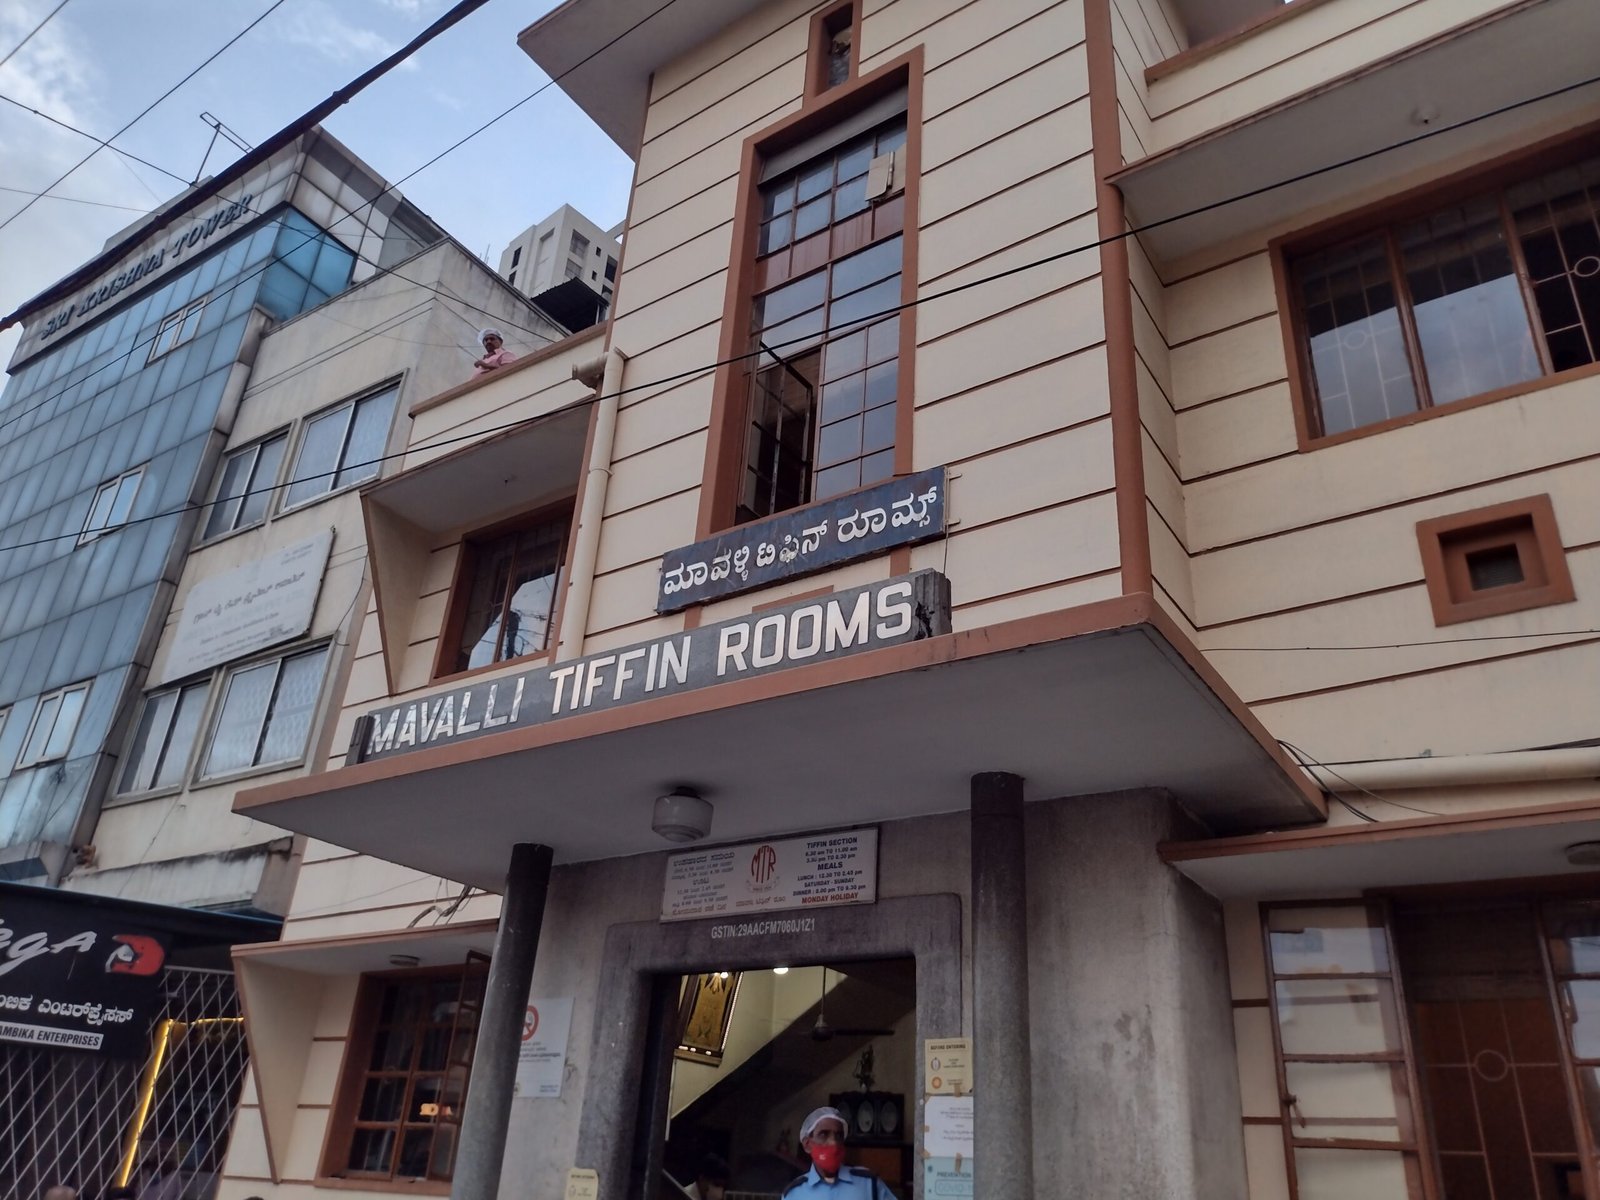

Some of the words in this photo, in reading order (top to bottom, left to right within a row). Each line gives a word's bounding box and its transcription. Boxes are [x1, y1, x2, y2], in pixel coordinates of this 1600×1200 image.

[77, 249, 165, 317] KRISHNA
[172, 194, 253, 259] TOWER
[664, 544, 750, 595] ಮಾವಳ್ಳಿ
[756, 519, 828, 568] ಟಿಫಿನ್
[838, 486, 937, 543] ರೂಮ್ಸ್
[366, 678, 525, 755] MAVALLI
[550, 635, 692, 715] TIFFIN
[716, 581, 913, 678] ROOMS
[807, 840, 827, 848] TIFFIN
[829, 837, 857, 846] SECTION
[751, 845, 776, 883] MTR
[818, 862, 843, 870] MEALS
[802, 894, 829, 904] MONDAY
[831, 892, 858, 901] HOLIDAY
[711, 918, 815, 939] GSTIN:29AACFM7060J1Z1
[37, 1030, 100, 1047] ENTERPRISES
